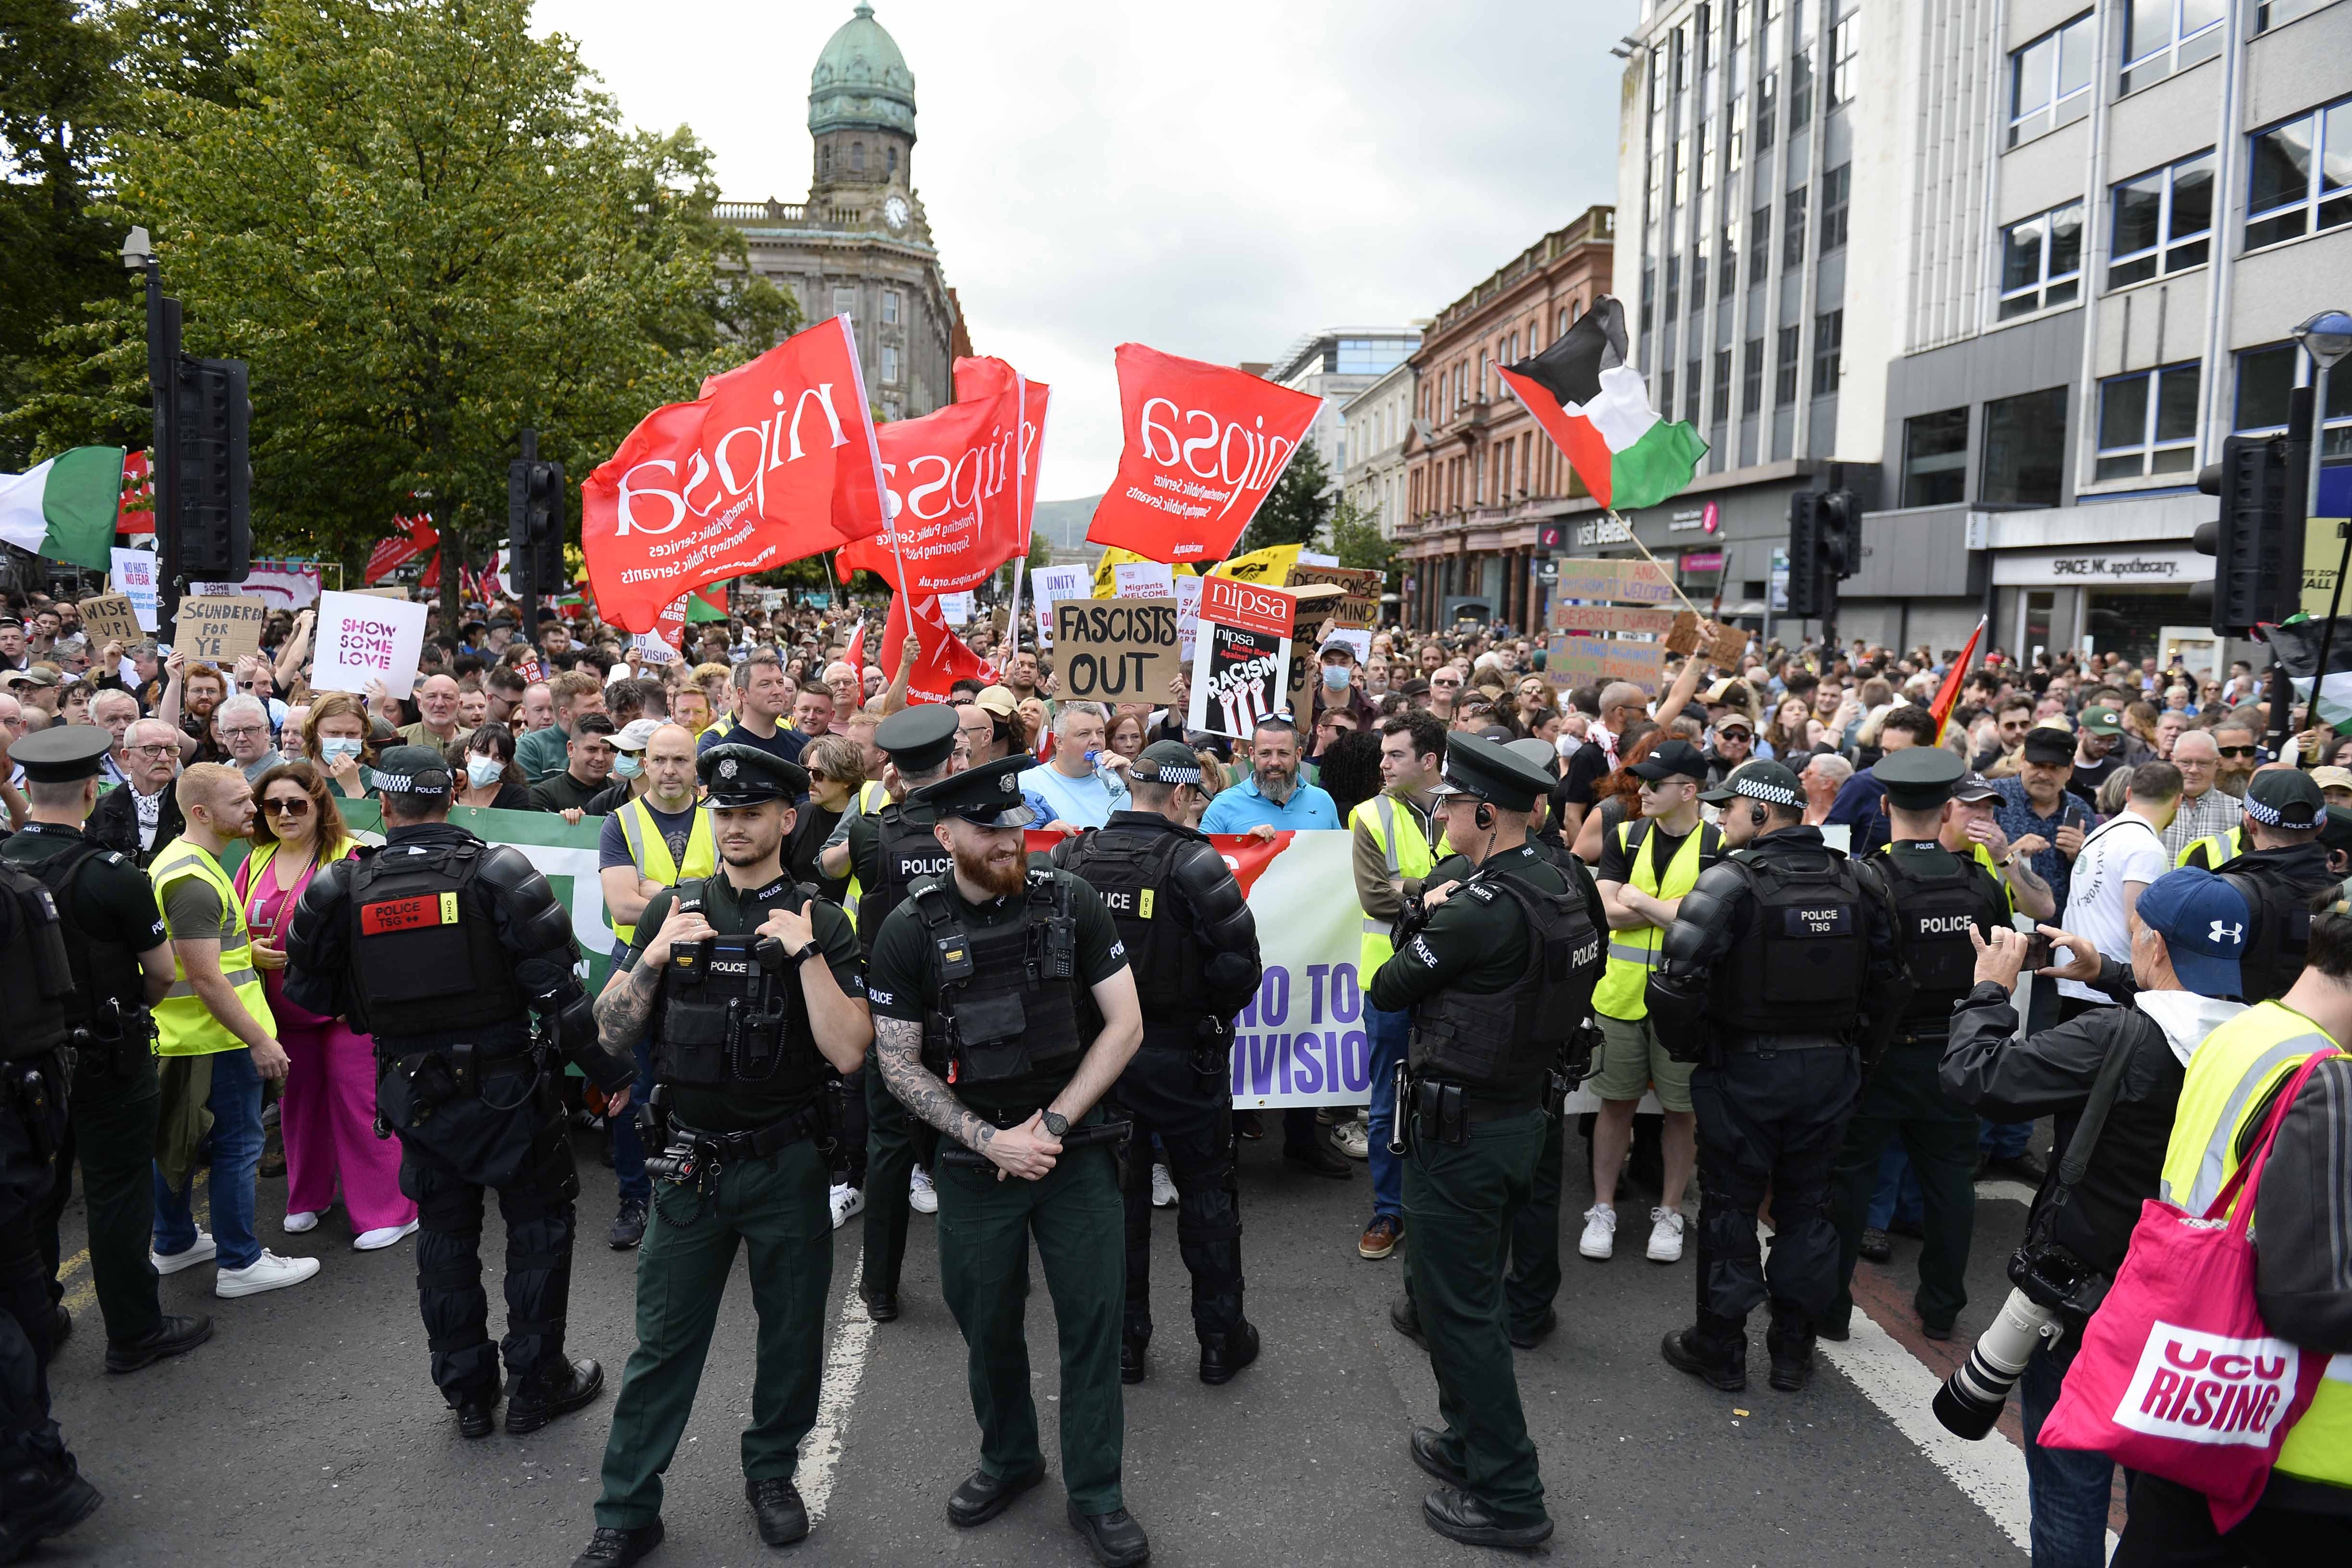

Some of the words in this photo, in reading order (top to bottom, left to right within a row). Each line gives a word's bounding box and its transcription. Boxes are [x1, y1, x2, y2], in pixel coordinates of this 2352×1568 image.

[1576, 522, 1596, 546] visit
[123, 561, 133, 573] NO
[134, 562, 148, 574] HATE
[1633, 565, 1657, 580] AND
[125, 573, 134, 584] NO
[135, 574, 150, 585] FEAR
[1047, 575, 1075, 590] UNITY
[1125, 582, 1163, 591] Migrants
[1624, 583, 1672, 599] WELCOME
[674, 602, 686, 612] ON
[1212, 583, 1287, 619] nipsa
[83, 601, 128, 620] WISE
[183, 602, 262, 620] SCUNDERED
[1333, 601, 1377, 622] MIND
[100, 620, 131, 638] UP!
[202, 623, 229, 635] FOR
[341, 618, 396, 637] SHOW
[1059, 605, 1177, 646] FASCISTS
[1557, 609, 1614, 625] DEPORT
[1624, 614, 1670, 631] NAZIS
[195, 637, 220, 656] YE
[340, 635, 392, 655] SOME
[635, 635, 646, 646] TO
[1216, 629, 1254, 649] nipsa
[1220, 649, 1249, 661] Against
[1231, 644, 1253, 654] Strike
[1550, 638, 1565, 654] WE
[1570, 640, 1608, 657] STAND
[1611, 645, 1657, 663] AGAINST
[339, 651, 391, 670] LOVE
[525, 662, 537, 672] TO
[1603, 661, 1656, 678] FASCISM
[529, 670, 541, 681] ON
[1069, 652, 1159, 696] OUT
[1207, 652, 1279, 700] RACISM
[758, 884, 783, 900] POLICE
[1469, 883, 1493, 900] 54072
[376, 901, 421, 917] POLICE
[1801, 910, 1838, 921] POLICE
[379, 916, 402, 926] TSG
[1810, 923, 1830, 932] TSG
[1921, 915, 1973, 934] POLICE
[1413, 935, 1438, 969] POLICE
[1572, 940, 1598, 969] POLICE
[710, 961, 747, 972] POLICE
[1306, 962, 1360, 1024] TO
[1232, 1030, 1370, 1095] IVISIO
[2165, 1339, 2286, 1381] UCU
[2140, 1366, 2281, 1434] RISING
